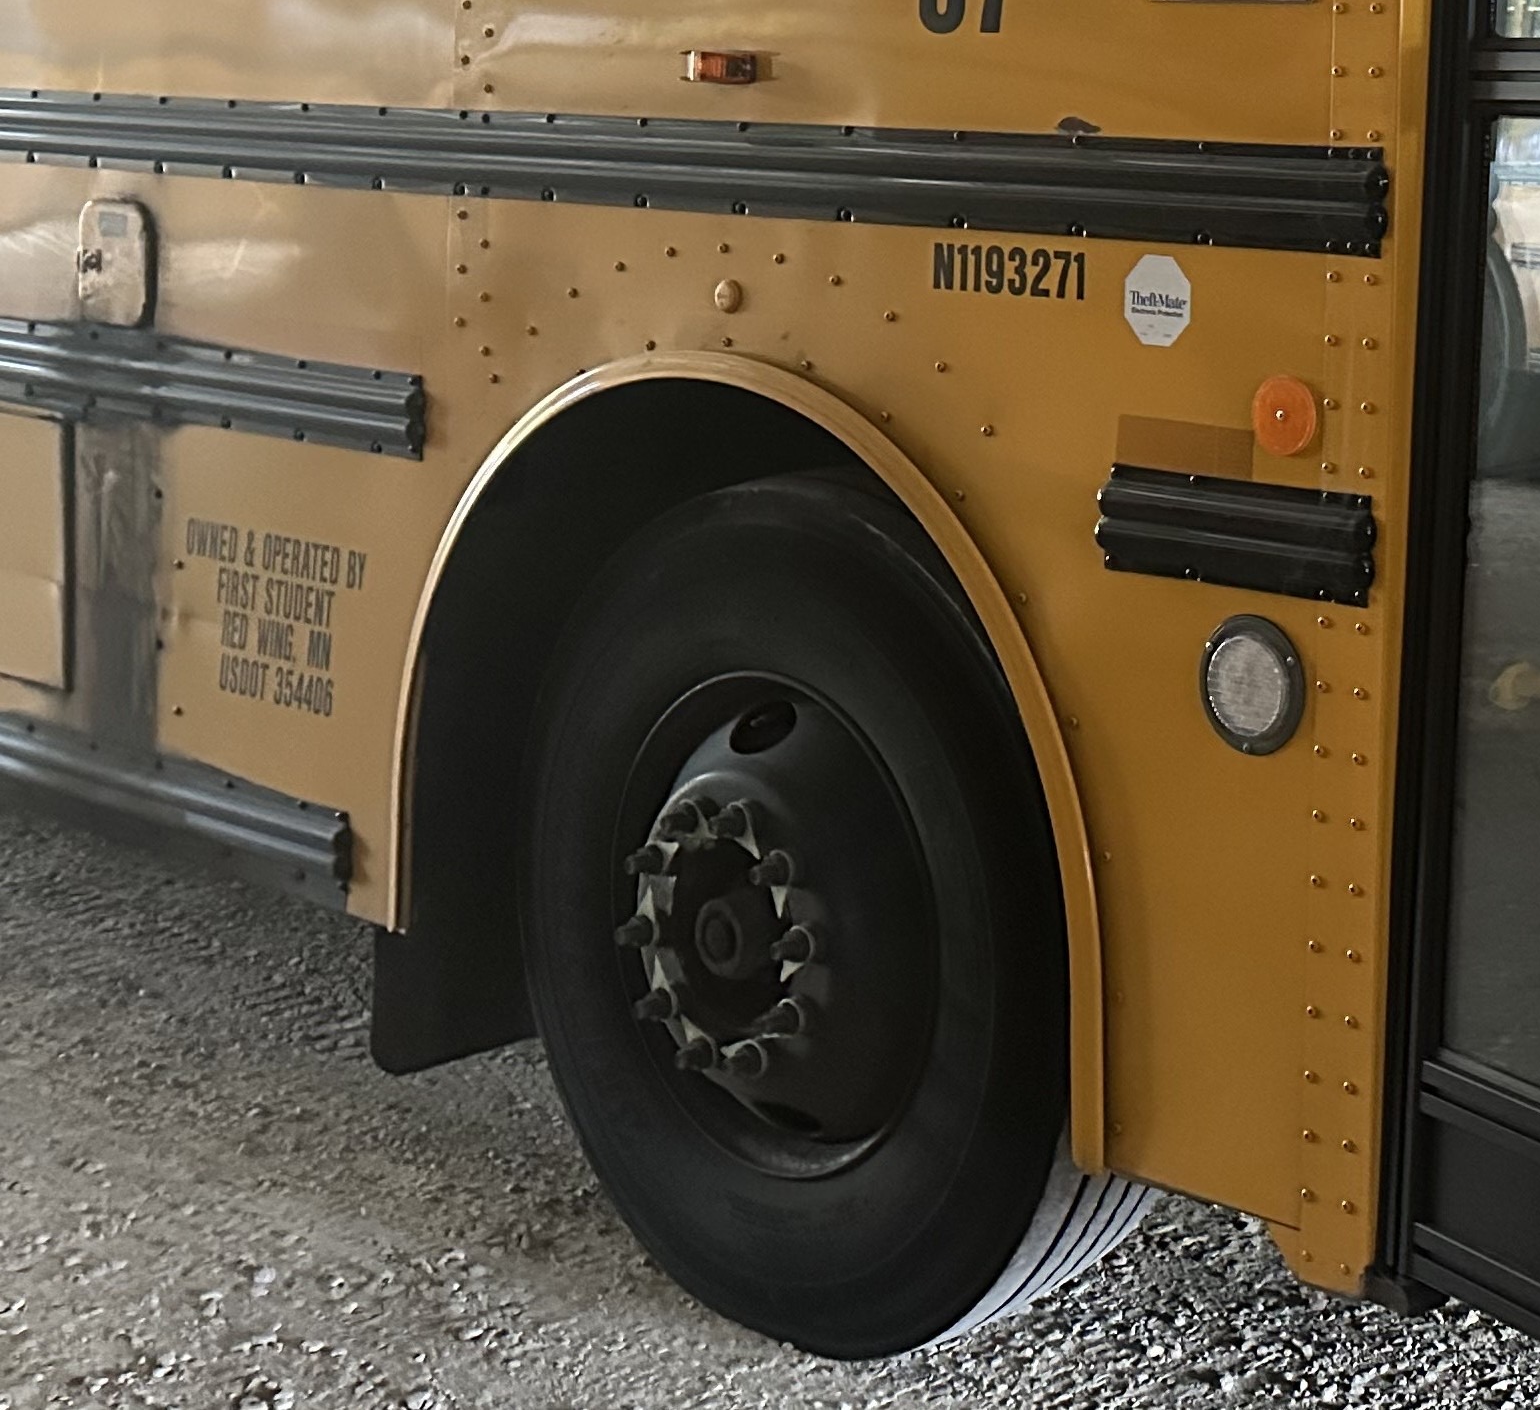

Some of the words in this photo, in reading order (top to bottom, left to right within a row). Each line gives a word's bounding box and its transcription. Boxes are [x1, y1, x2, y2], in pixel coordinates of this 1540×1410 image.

[933, 242, 1086, 301] N1193271
[186, 517, 238, 564] OWNED
[243, 529, 256, 568] &
[262, 532, 341, 586] OPERATED
[346, 549, 368, 591] BY
[216, 565, 260, 612] FIRST
[264, 576, 336, 629] STUDENT
[221, 609, 249, 651] RED
[307, 629, 333, 672] MN
[219, 652, 270, 701] USDOT
[273, 666, 335, 718] 354406
